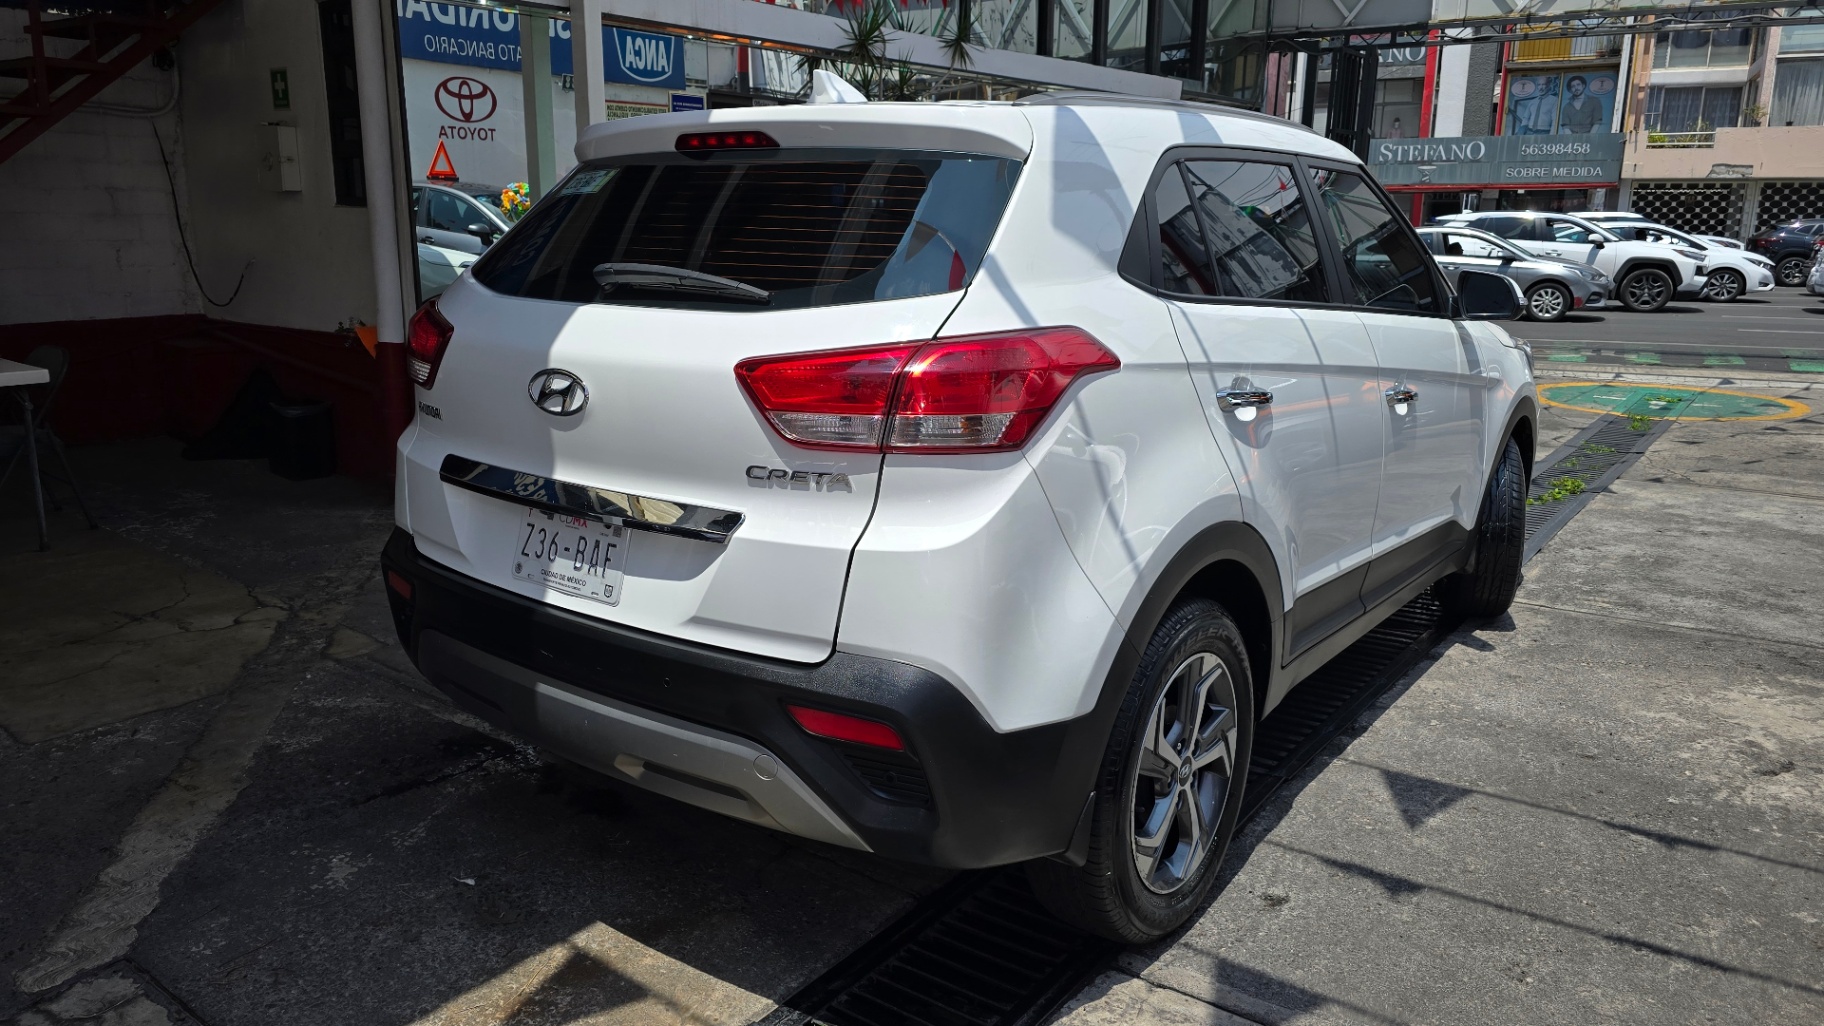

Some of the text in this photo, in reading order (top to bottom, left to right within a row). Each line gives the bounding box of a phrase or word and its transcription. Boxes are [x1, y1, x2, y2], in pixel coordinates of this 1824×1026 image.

[1378, 141, 1591, 162] STEFANO 56398458
[1505, 166, 1602, 178] SOBRE MEDIDA
[745, 464, 853, 492] CRETA
[521, 522, 618, 579] Z36-BAF
[540, 568, 559, 579] CIUDAD
